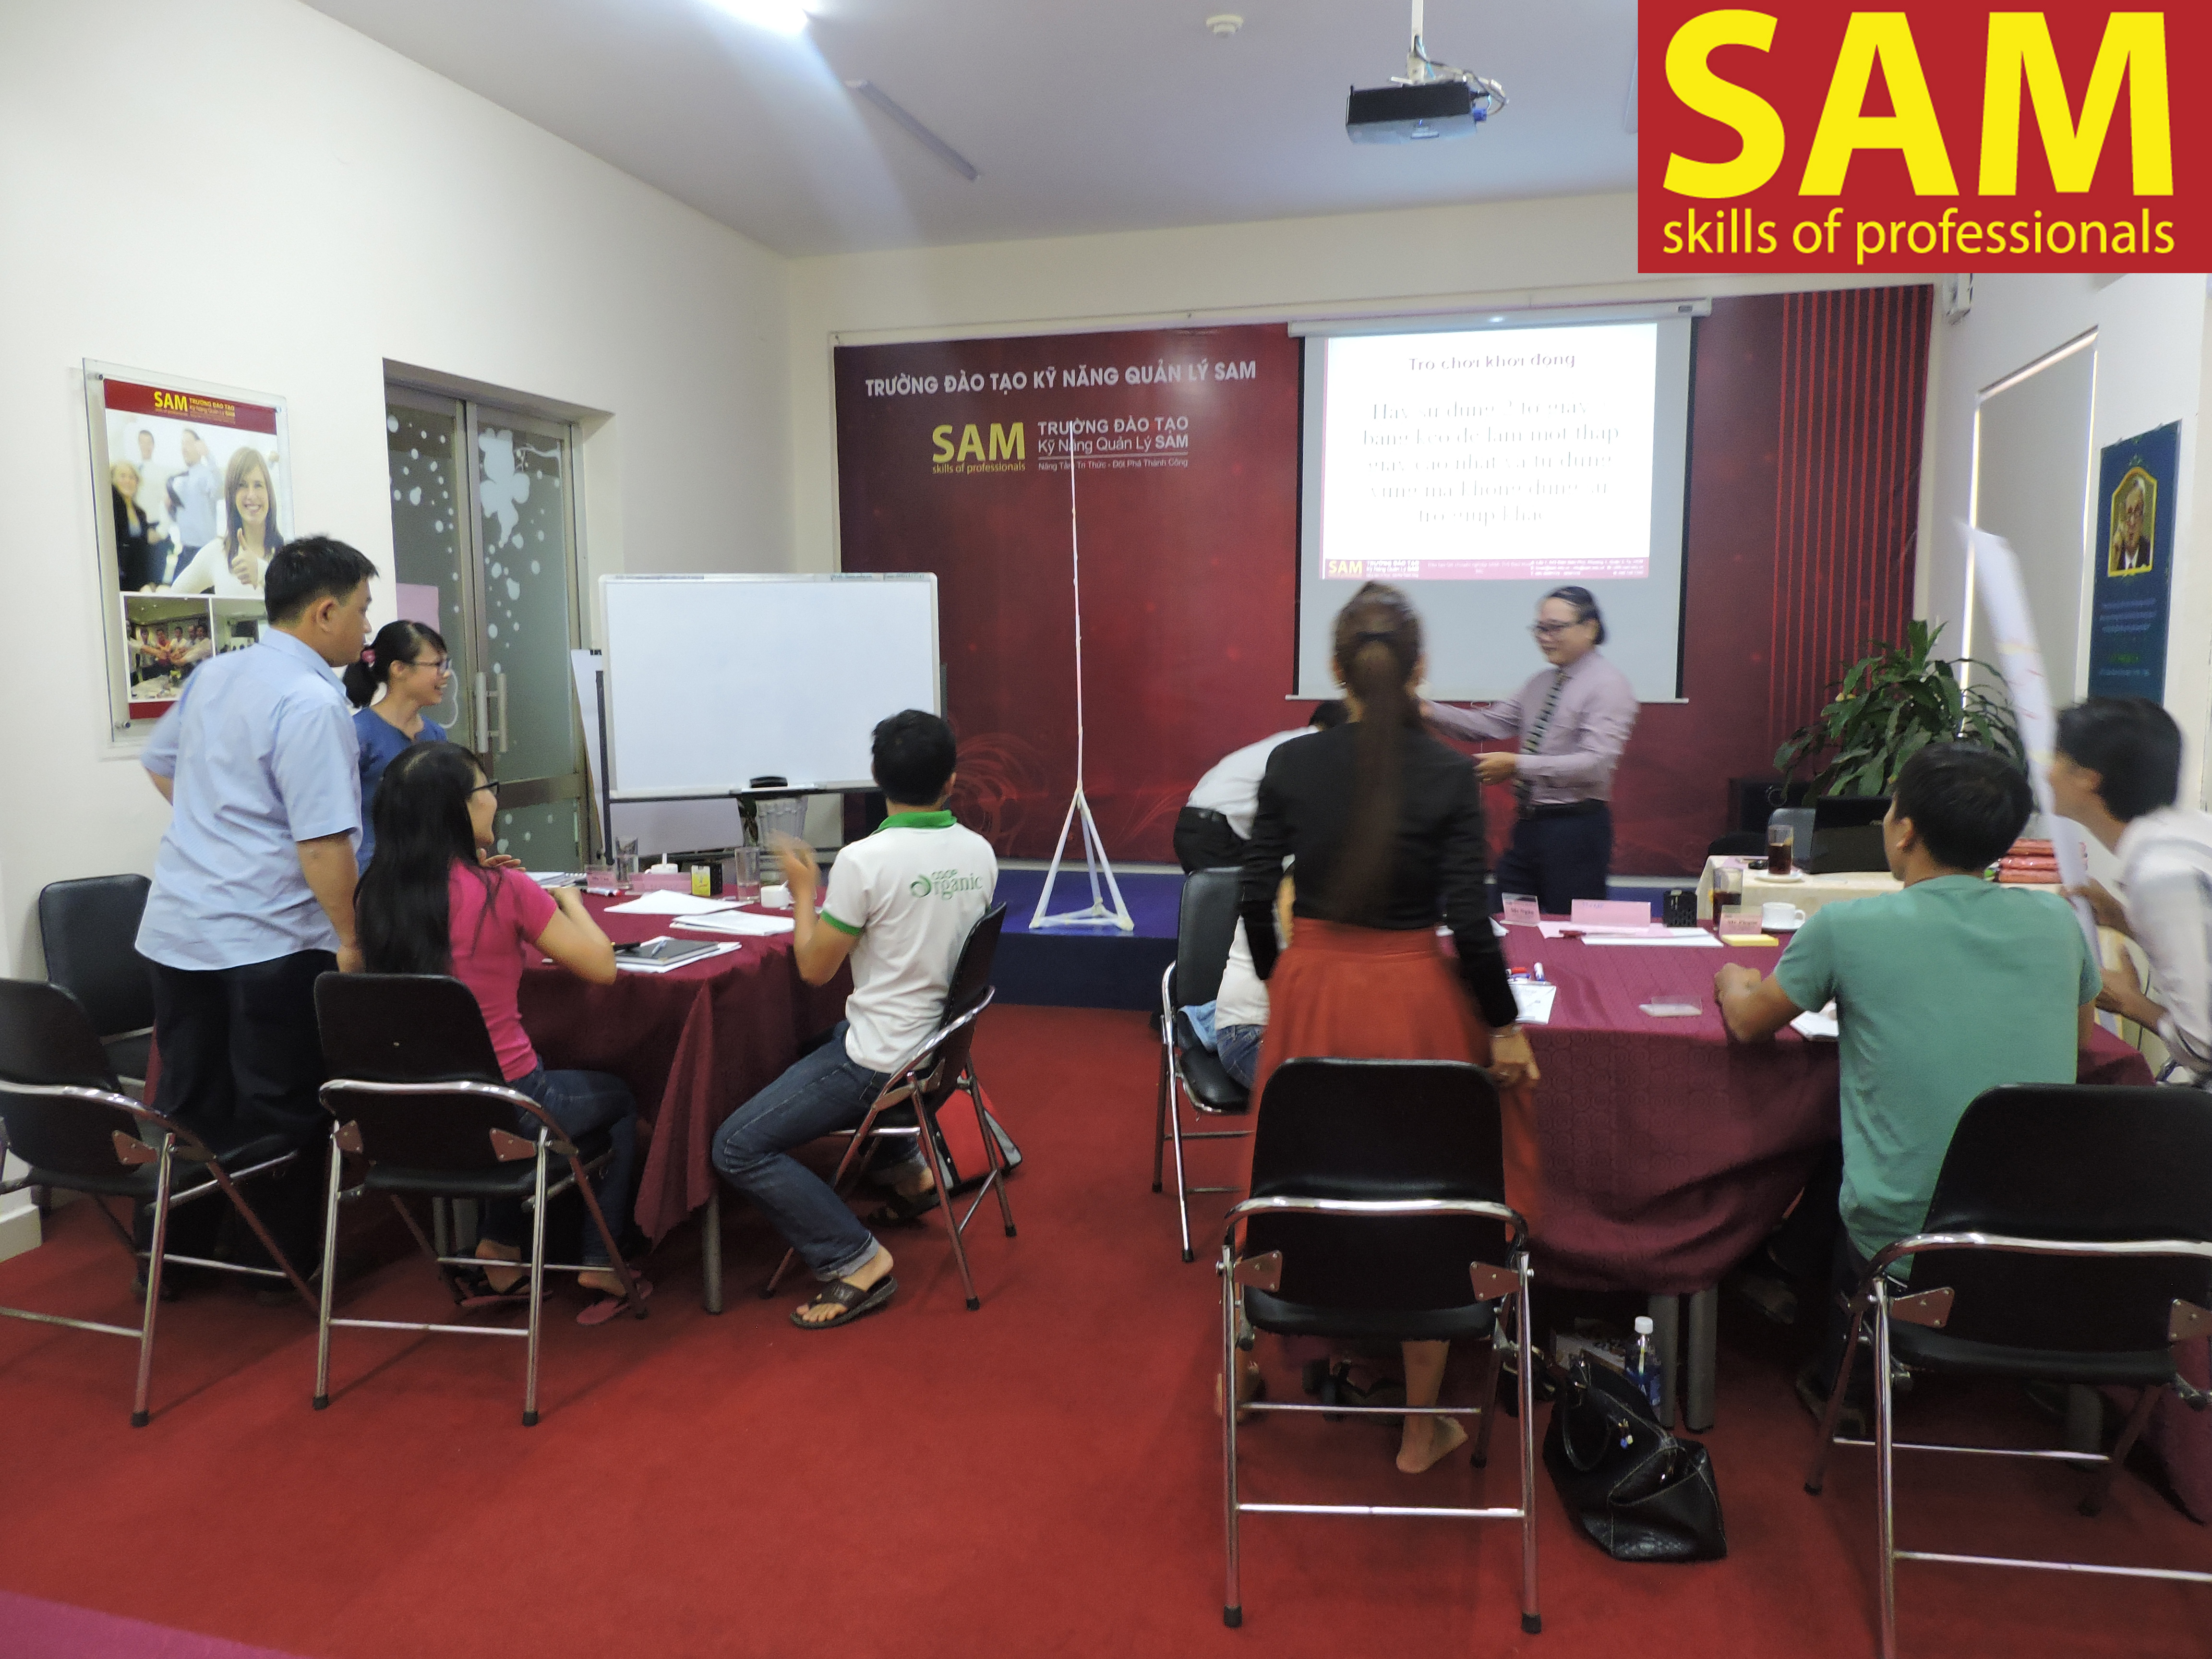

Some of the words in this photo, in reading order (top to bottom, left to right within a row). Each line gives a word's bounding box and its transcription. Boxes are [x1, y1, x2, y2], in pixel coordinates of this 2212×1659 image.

[866, 373, 938, 397] TRƯỜNG
[944, 369, 985, 393] ĐÀO
[990, 372, 1027, 395] TẠO
[1063, 364, 1119, 387] NĂNG
[1125, 358, 1181, 384] QUẢN
[1189, 358, 1208, 382] LÝ
[1214, 361, 1256, 382] SAM
[154, 391, 188, 412] SAM
[1114, 415, 1149, 433] ĐÀO
[1154, 416, 1189, 434] TẠO
[932, 422, 1025, 463] SAM
[1136, 435, 1152, 453] Lý
[1155, 434, 1188, 449] SAM
[933, 464, 953, 474] skills
[956, 462, 965, 473] of
[967, 461, 1025, 475] professionals
[1329, 560, 1362, 574] SAM
